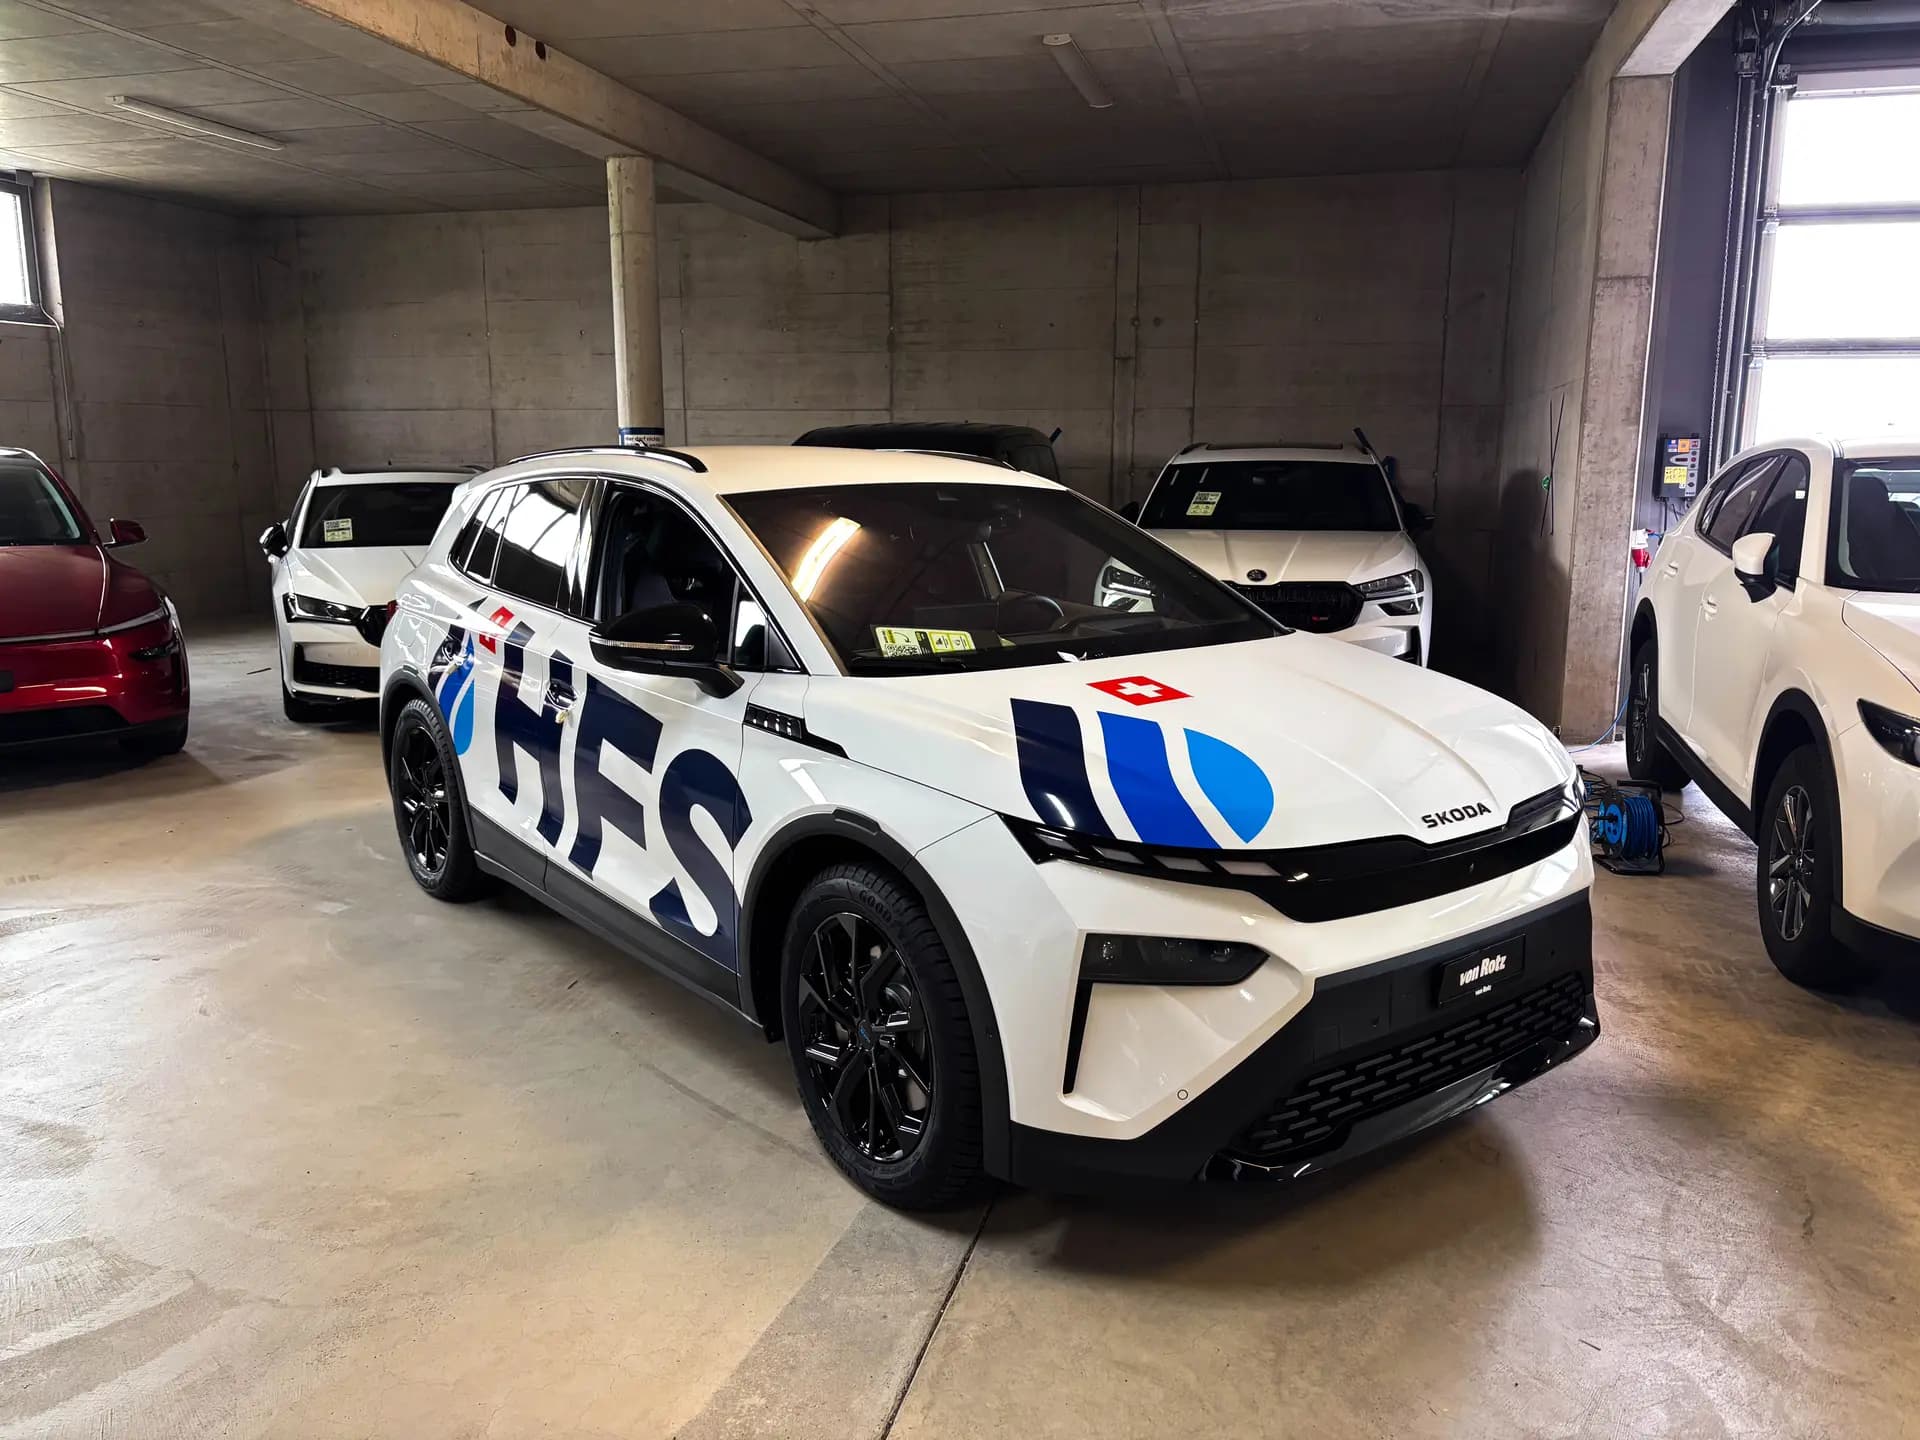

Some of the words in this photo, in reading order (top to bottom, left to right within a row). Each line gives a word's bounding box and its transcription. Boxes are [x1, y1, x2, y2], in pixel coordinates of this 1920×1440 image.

[494, 620, 753, 973] HFS
[1459, 965, 1480, 986] von
[1480, 954, 1507, 977] Rotz
